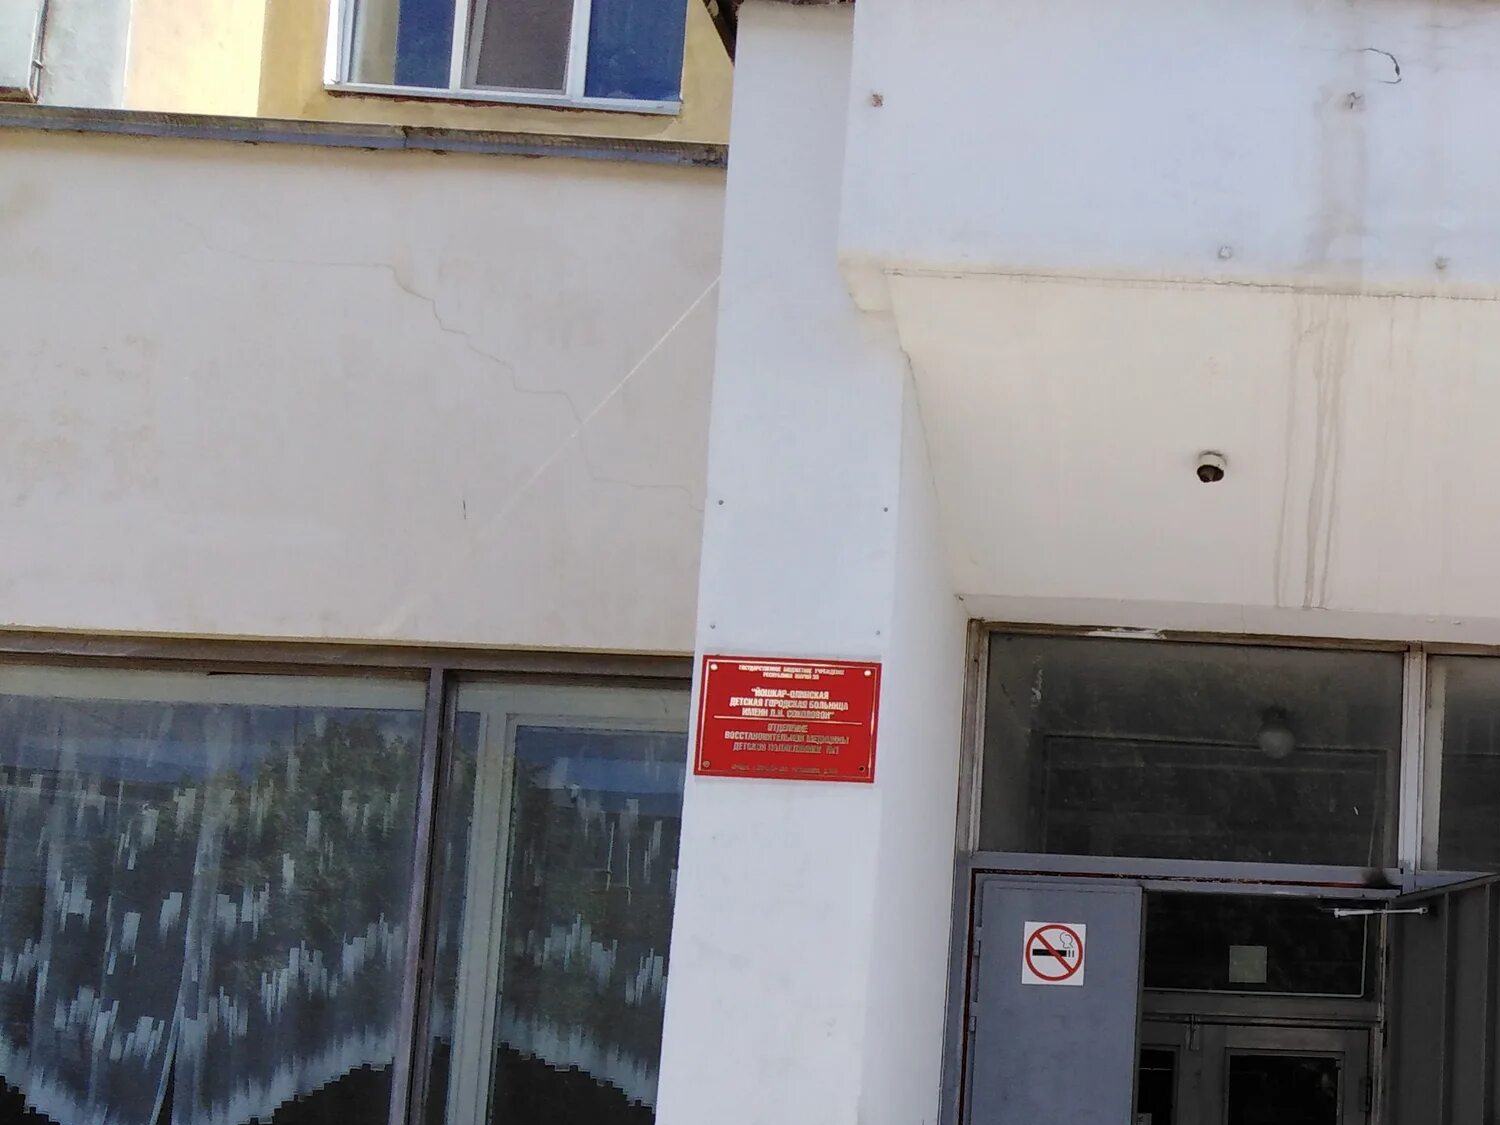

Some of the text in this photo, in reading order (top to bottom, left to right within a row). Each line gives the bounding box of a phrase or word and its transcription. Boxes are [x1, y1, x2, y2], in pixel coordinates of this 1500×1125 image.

[729, 697, 849, 711] ДЕТСКАЯ ГОРОДСКАЯ БОЛЬНИЦА
